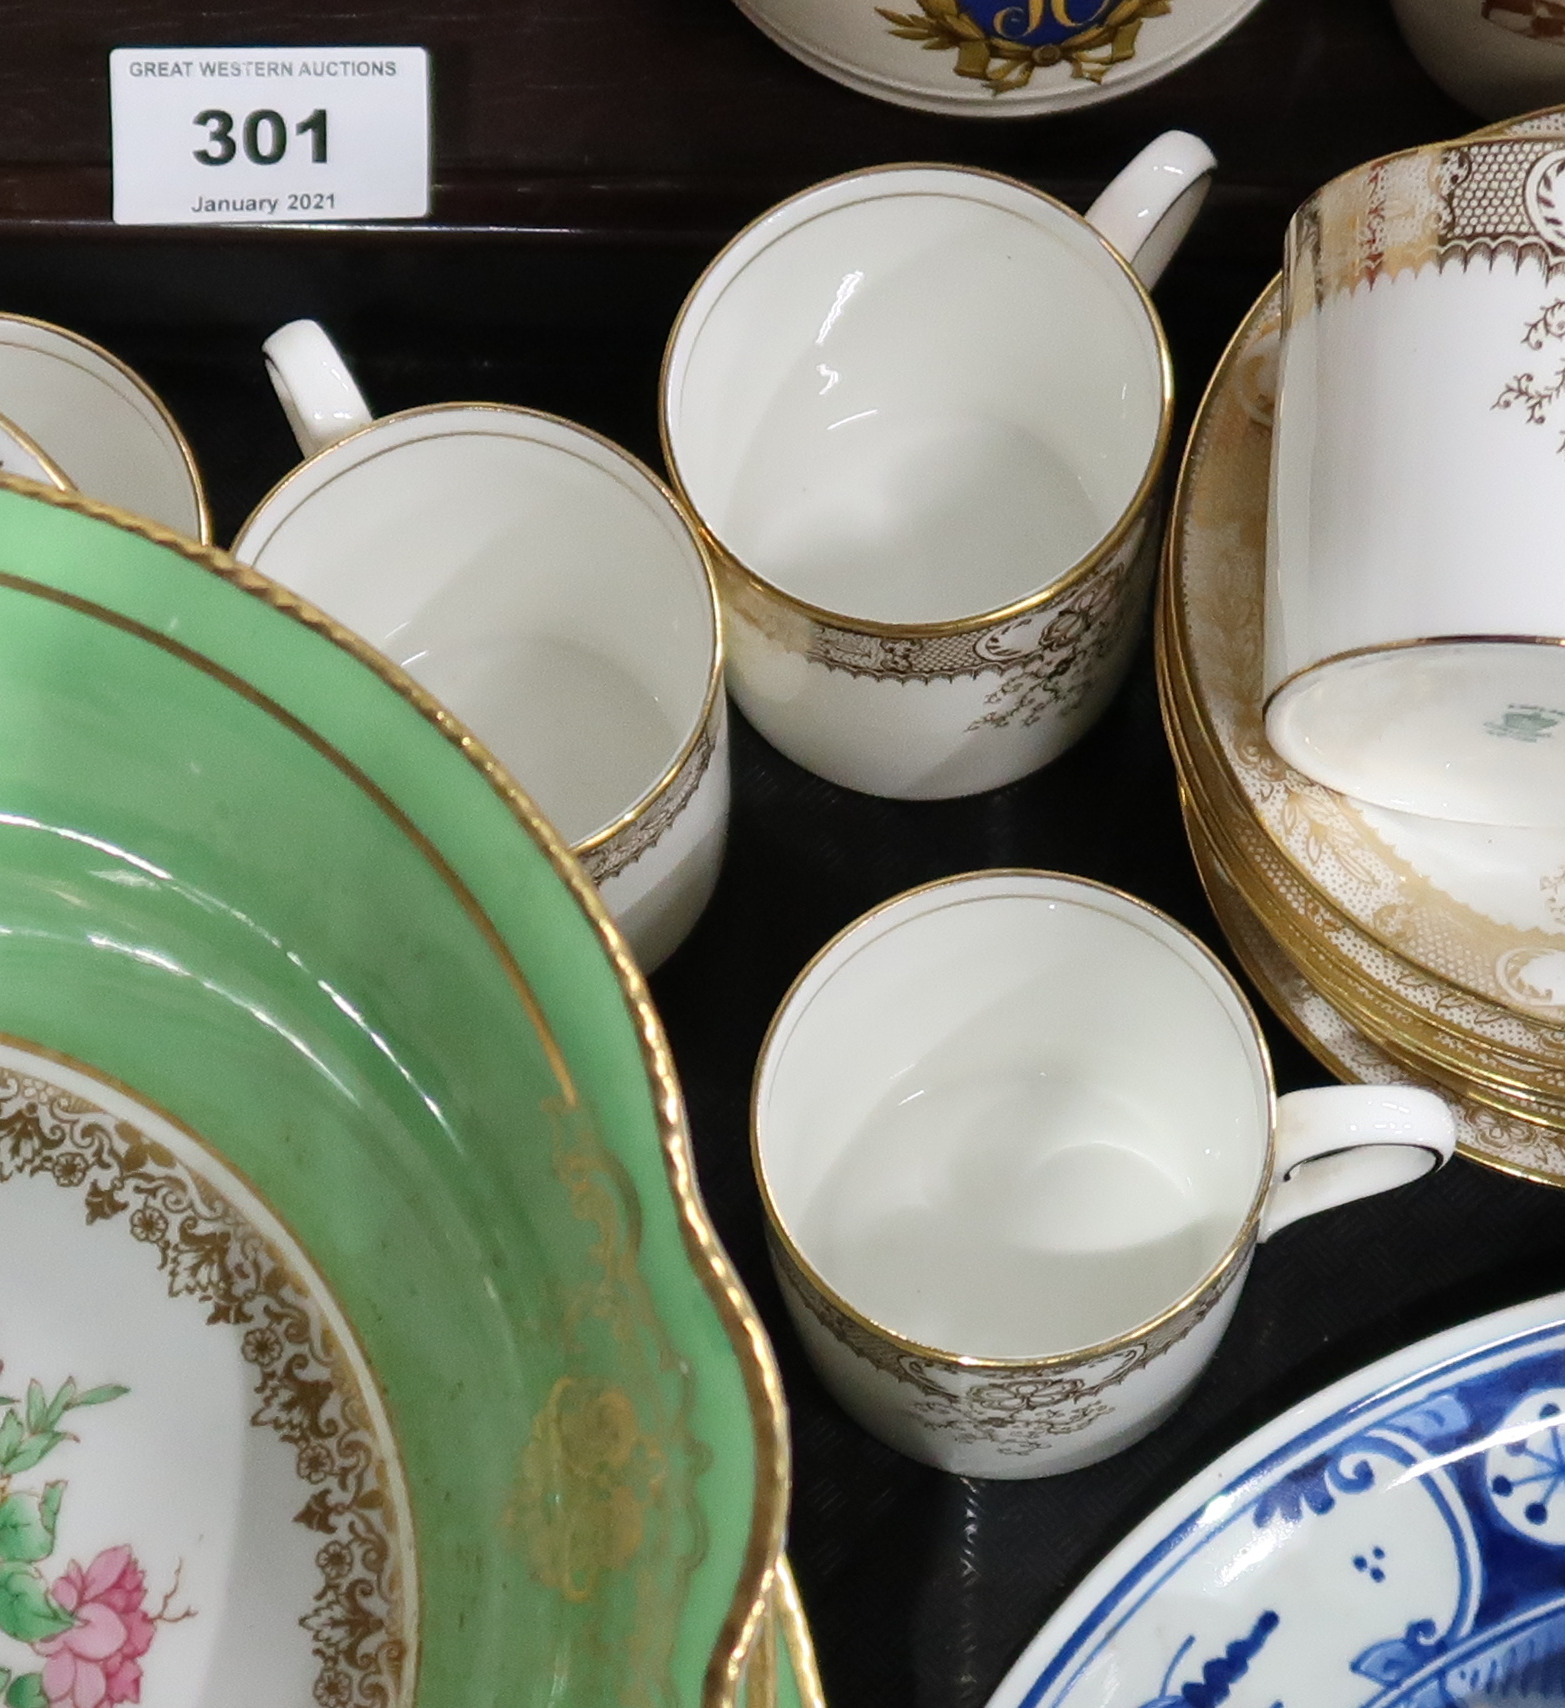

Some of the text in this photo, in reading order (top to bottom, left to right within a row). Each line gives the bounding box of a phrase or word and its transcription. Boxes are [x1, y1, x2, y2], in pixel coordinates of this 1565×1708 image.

[129, 61, 397, 78] GREAT WESTERN AUCTIONS
[191, 109, 328, 166] 301
[191, 193, 336, 215] January 2021
